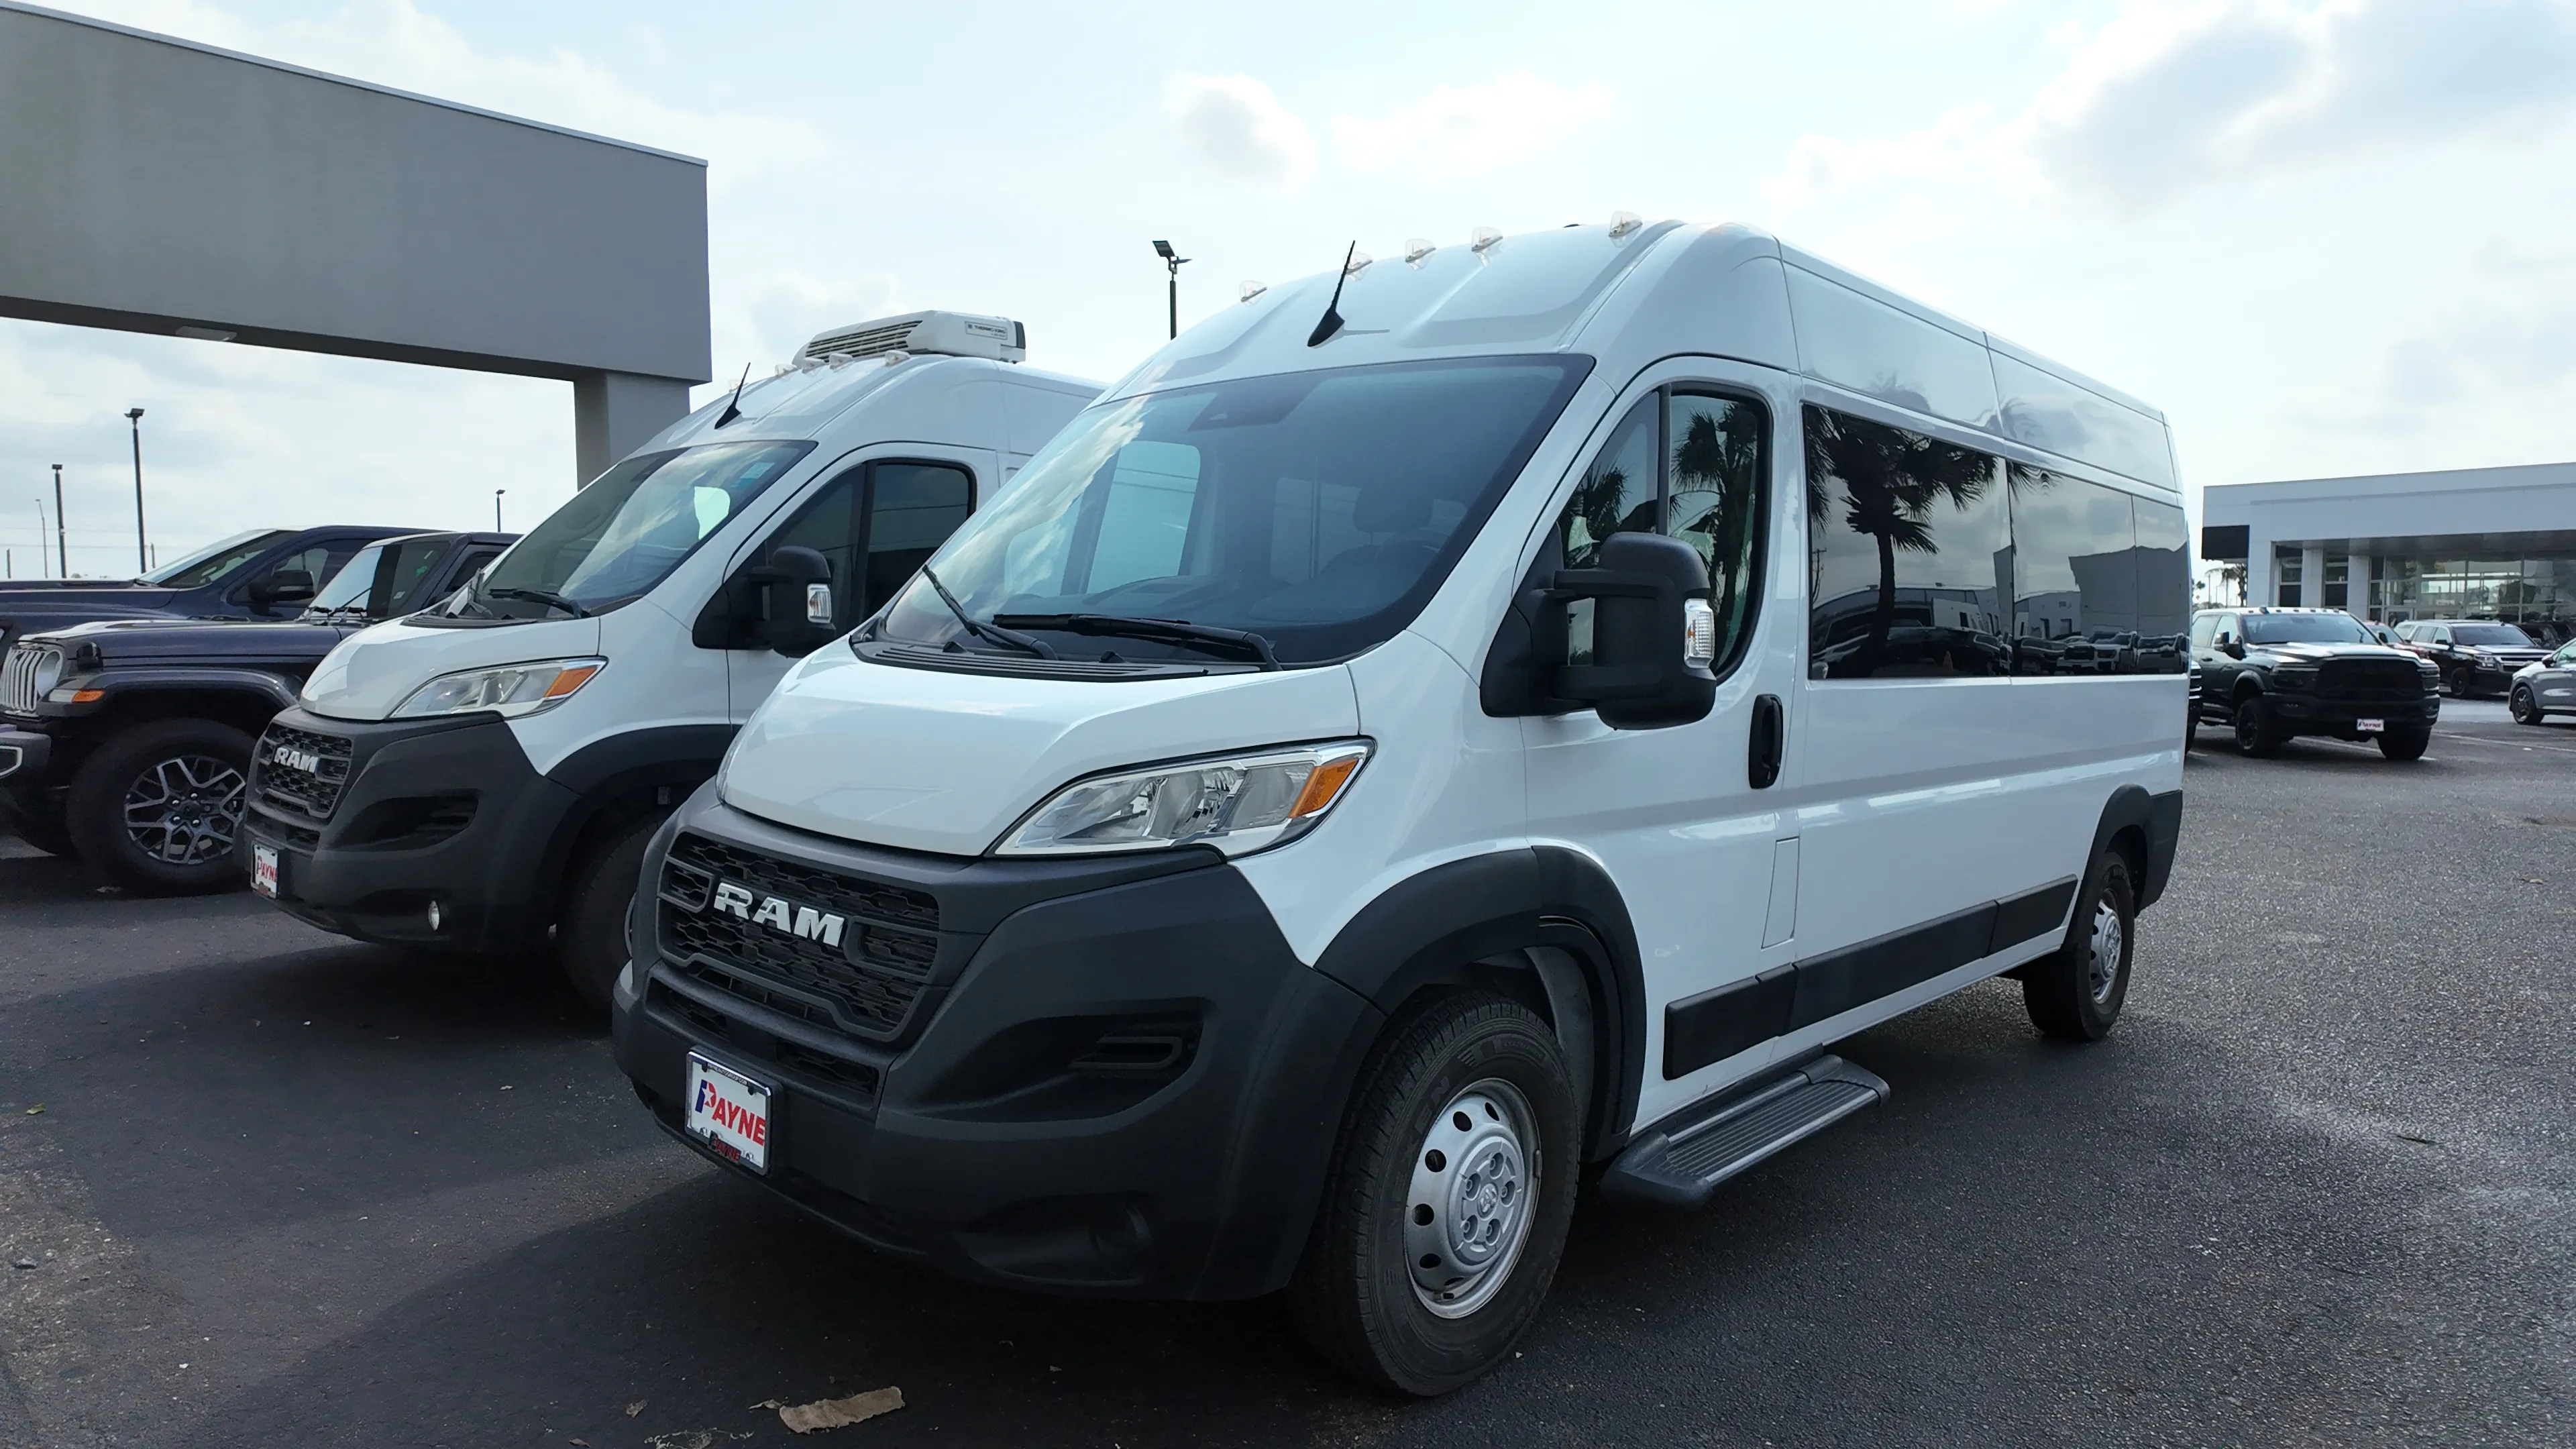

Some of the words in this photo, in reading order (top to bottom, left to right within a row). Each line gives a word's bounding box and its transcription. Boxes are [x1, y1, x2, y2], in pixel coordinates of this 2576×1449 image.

[274, 747, 319, 773] RAM
[714, 882, 845, 947] RAM
[695, 1079, 766, 1146] PAYNE
